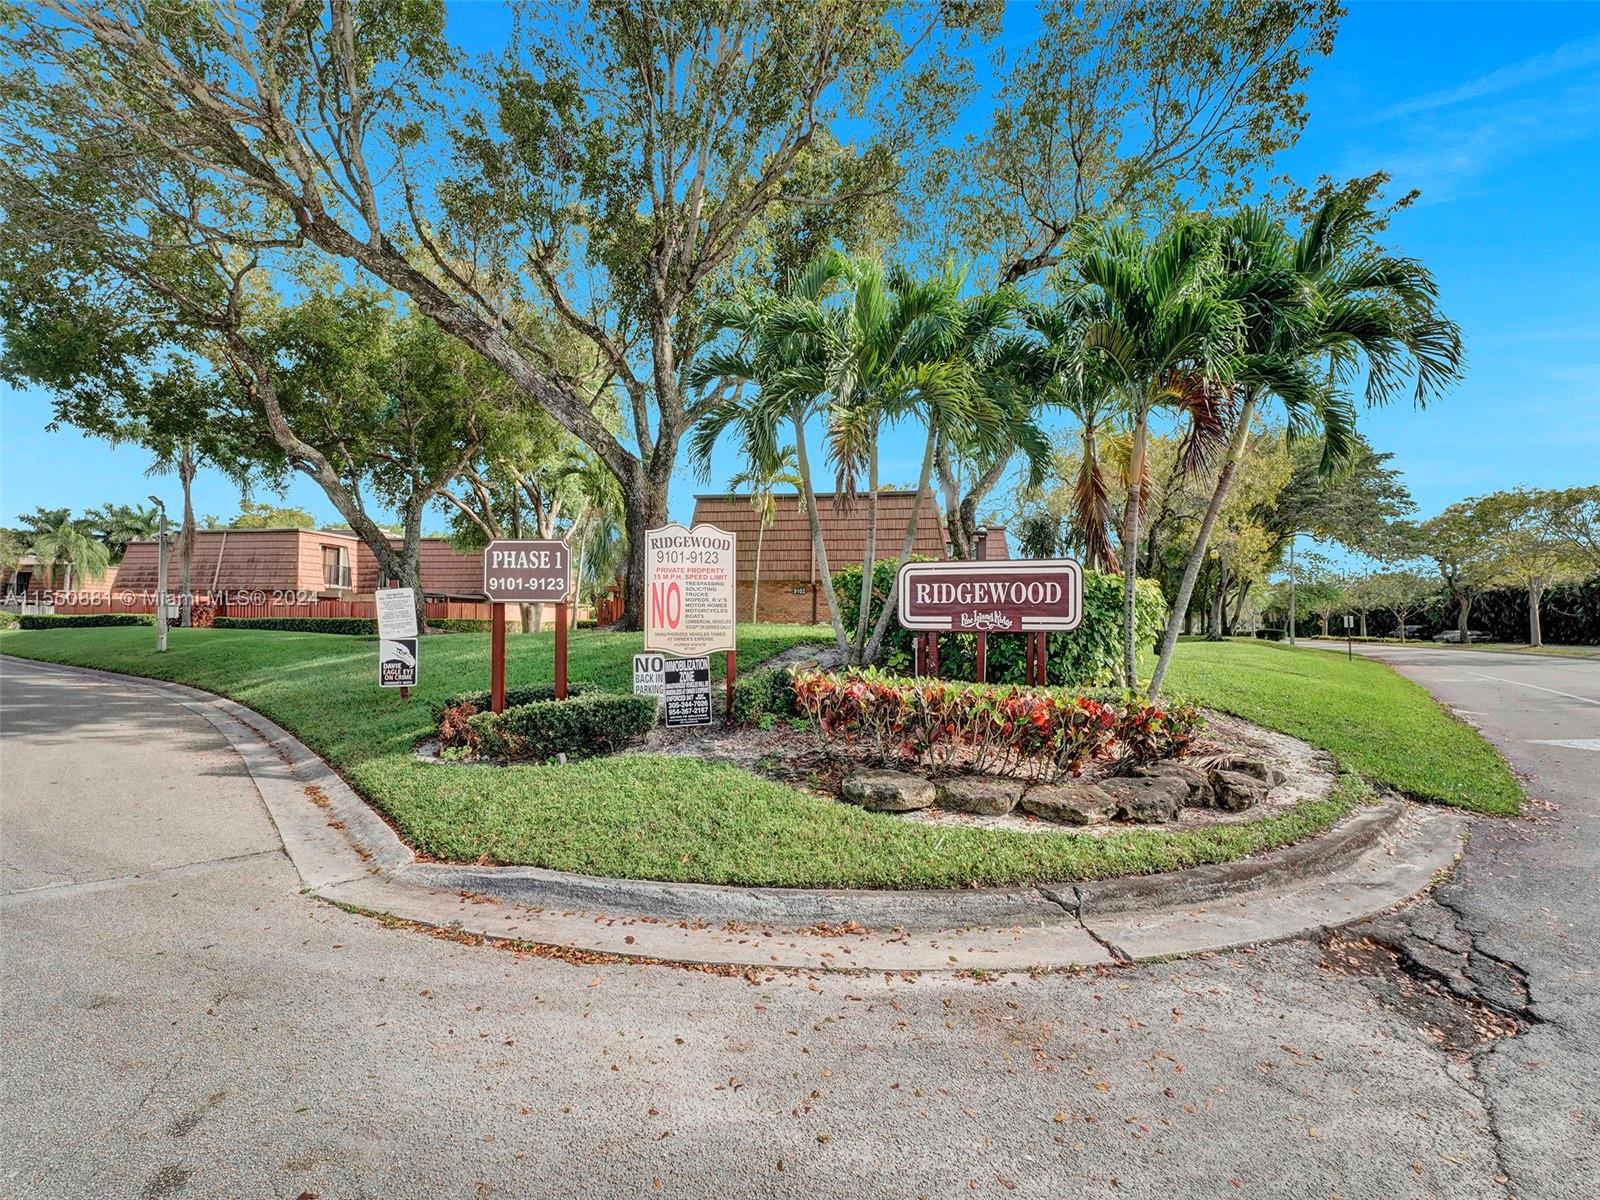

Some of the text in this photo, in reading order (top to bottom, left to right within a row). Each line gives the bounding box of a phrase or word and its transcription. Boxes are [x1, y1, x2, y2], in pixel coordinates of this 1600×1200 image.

[650, 536, 731, 551] RIDGEWOOD
[492, 551, 562, 569] PHASE 1
[656, 551, 719, 564] 9101-9123
[489, 577, 565, 590] 9101-9123
[915, 581, 1062, 605] RIDGEWOOD
[652, 581, 682, 630] NO
[635, 657, 664, 672] NO
[665, 658, 708, 672] IMMOBILIZATION
[635, 673, 664, 684] BACK IN
[679, 671, 695, 683] ZONE
[635, 685, 664, 694] PARKING
